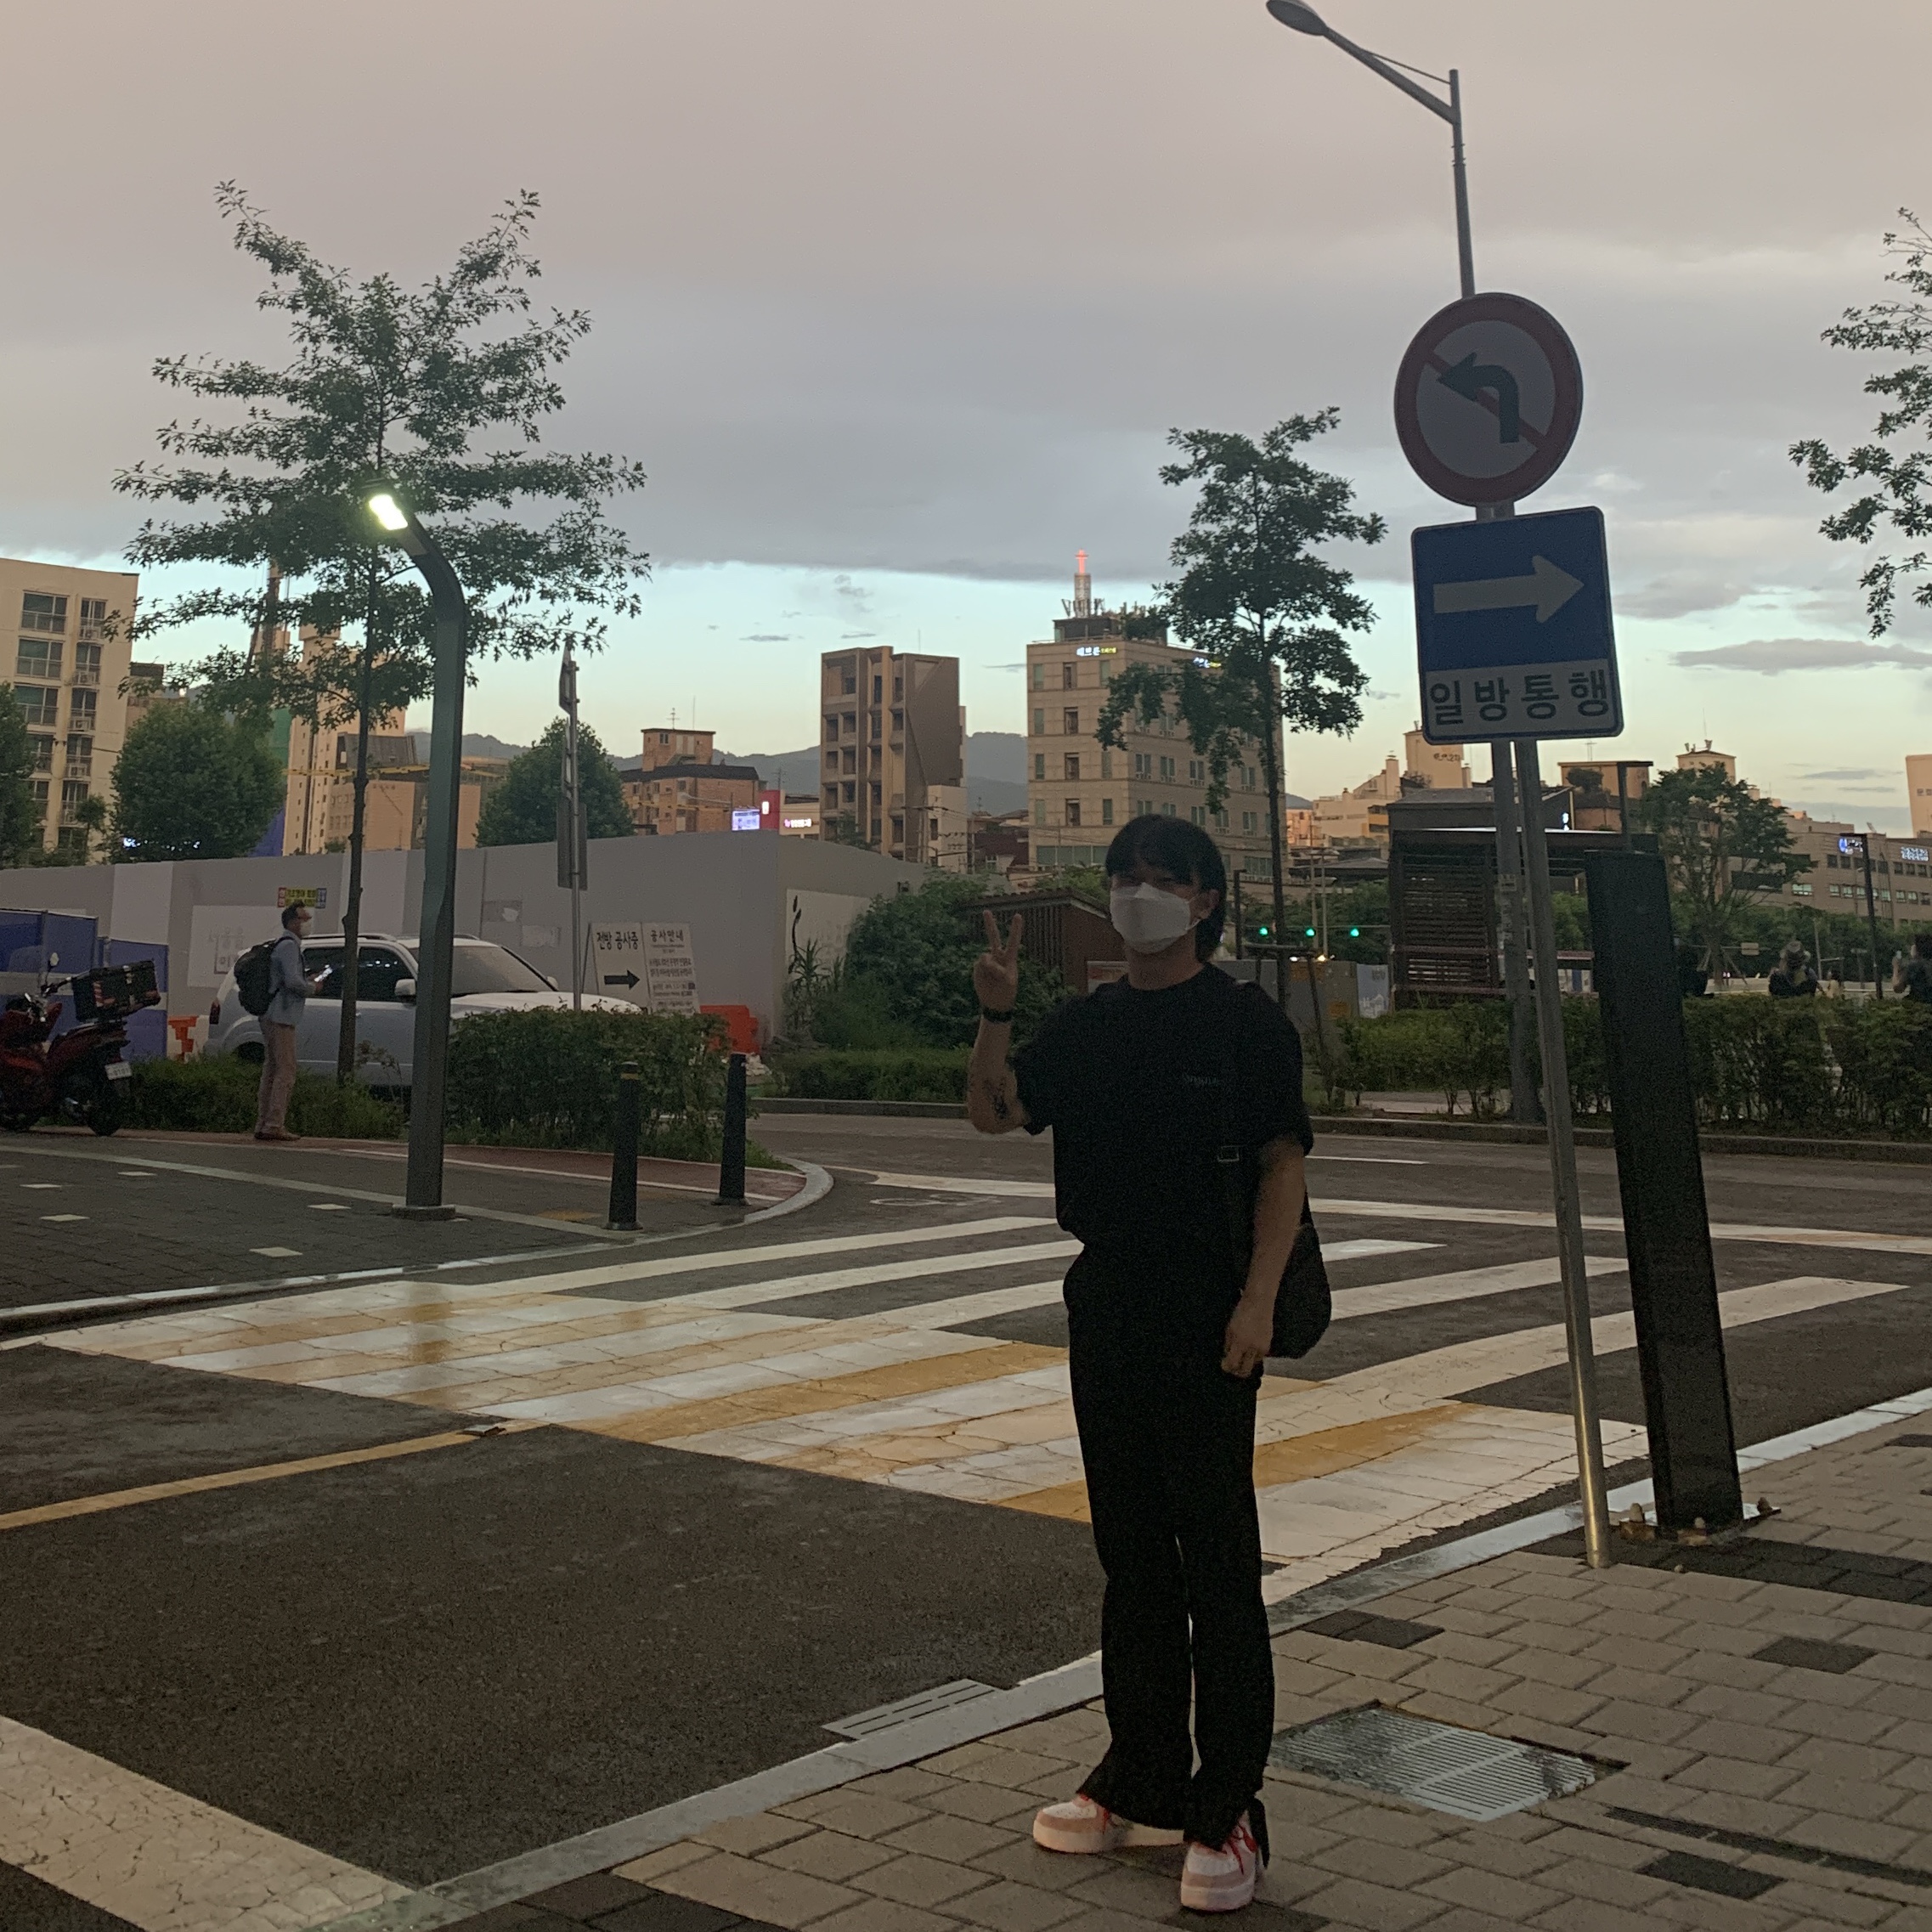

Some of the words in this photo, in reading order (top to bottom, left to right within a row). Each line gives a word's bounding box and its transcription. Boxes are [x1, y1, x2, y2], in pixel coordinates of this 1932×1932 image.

[1429, 669, 1609, 726] 일방통행
[596, 931, 612, 950] 전방
[615, 931, 639, 950] 공사중
